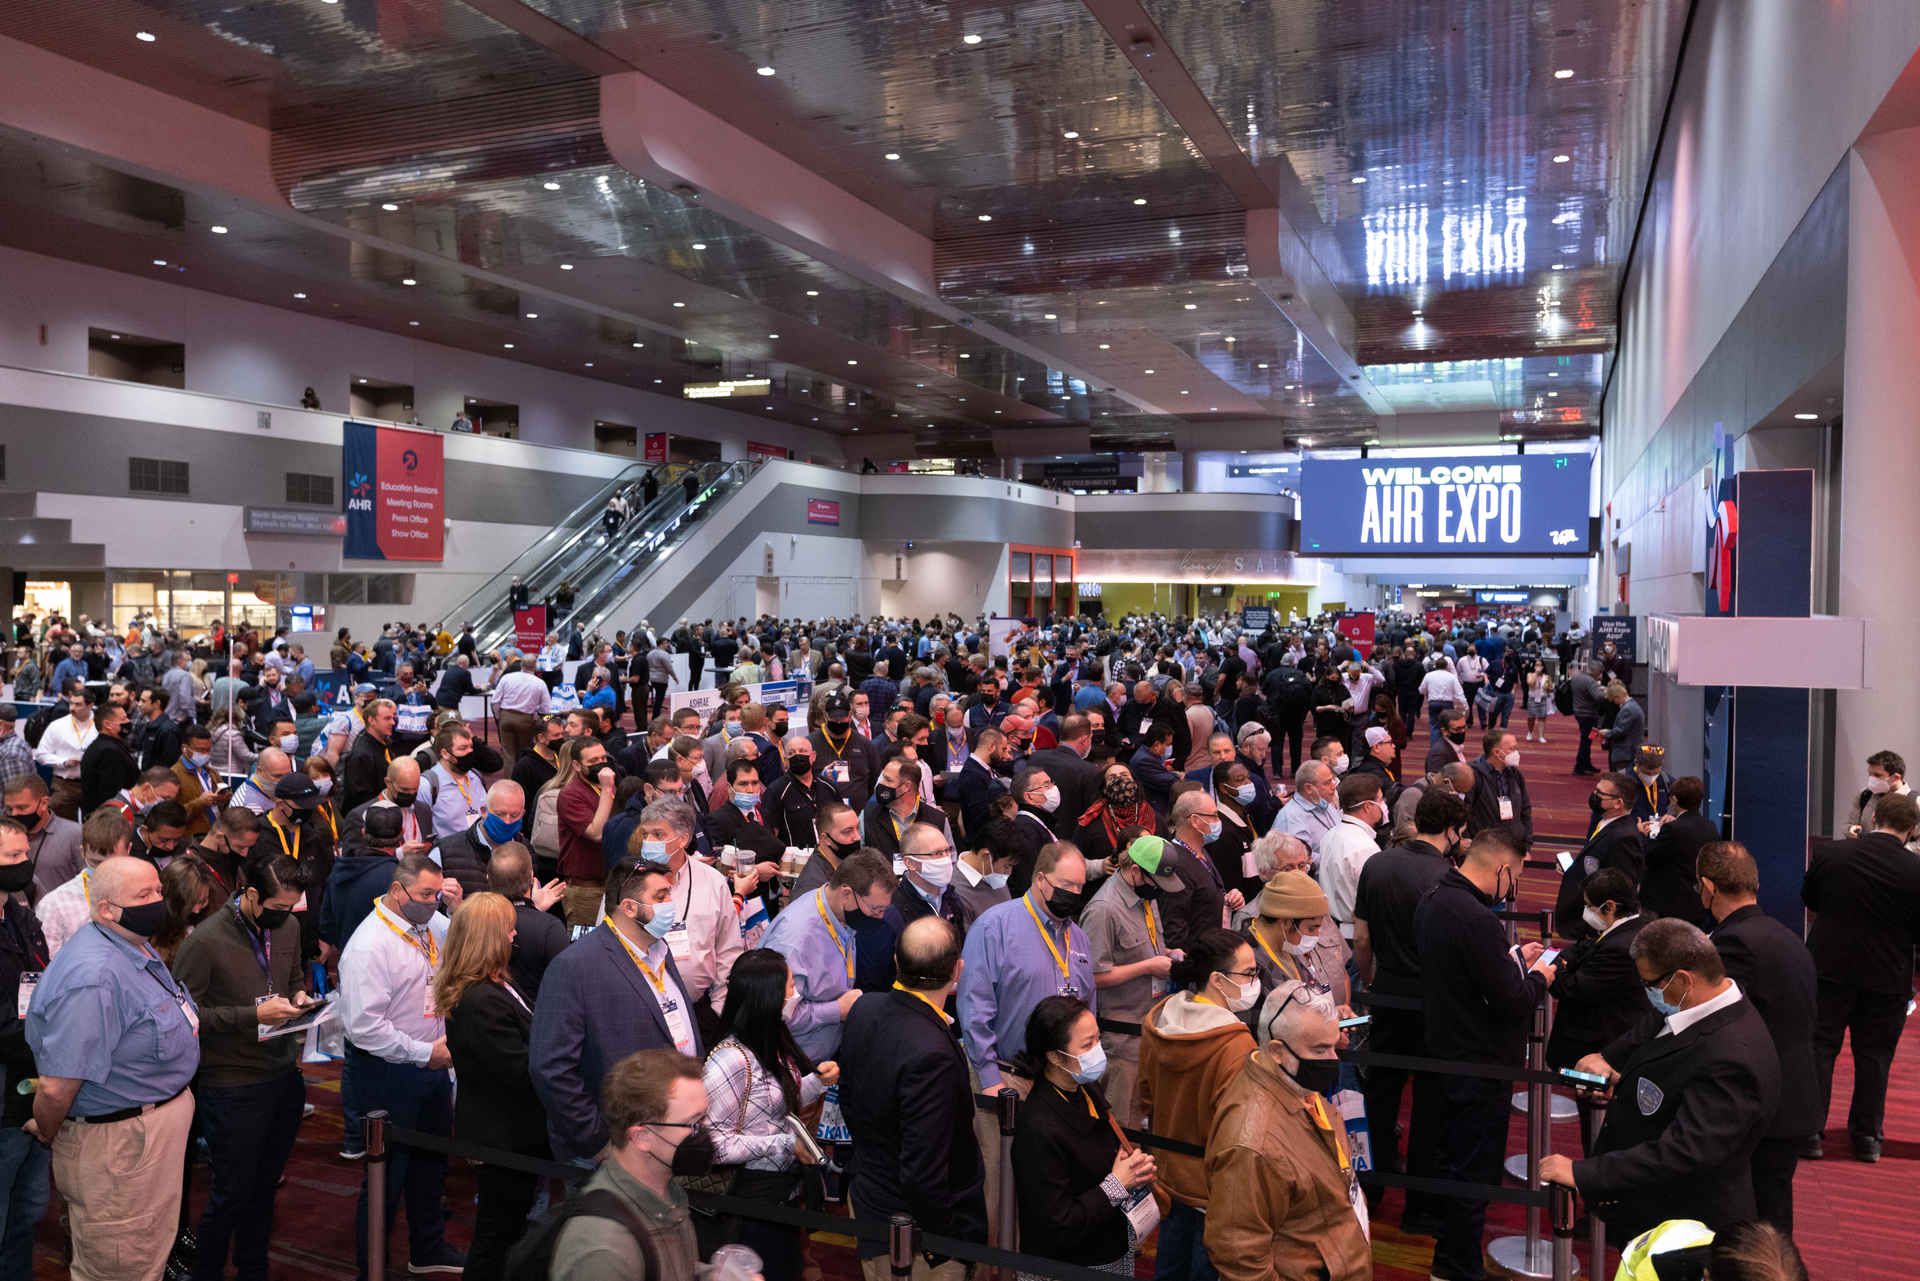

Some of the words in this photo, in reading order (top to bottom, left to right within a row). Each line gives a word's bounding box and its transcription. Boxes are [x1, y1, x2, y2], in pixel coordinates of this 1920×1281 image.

[1361, 465, 1522, 485] WELCOME
[381, 482, 413, 493] Education
[413, 485, 438, 495] Sessions
[1062, 479, 1117, 487] REFRESHMENTS
[348, 498, 372, 511] AHR
[386, 498, 412, 510] Meeting
[413, 500, 433, 509] Rooms
[251, 511, 271, 519] North
[271, 513, 296, 522] Meeting
[297, 514, 319, 522] Rooms
[1360, 485, 1424, 543] AHR
[1438, 483, 1522, 543] EXPO
[252, 520, 279, 528] Skywalk
[392, 514, 409, 523] Press
[410, 515, 428, 524] Office
[391, 529, 408, 538] Show
[410, 530, 429, 539] Office
[1234, 557, 1287, 573] SAL
[689, 697, 710, 708] ASHRAE
